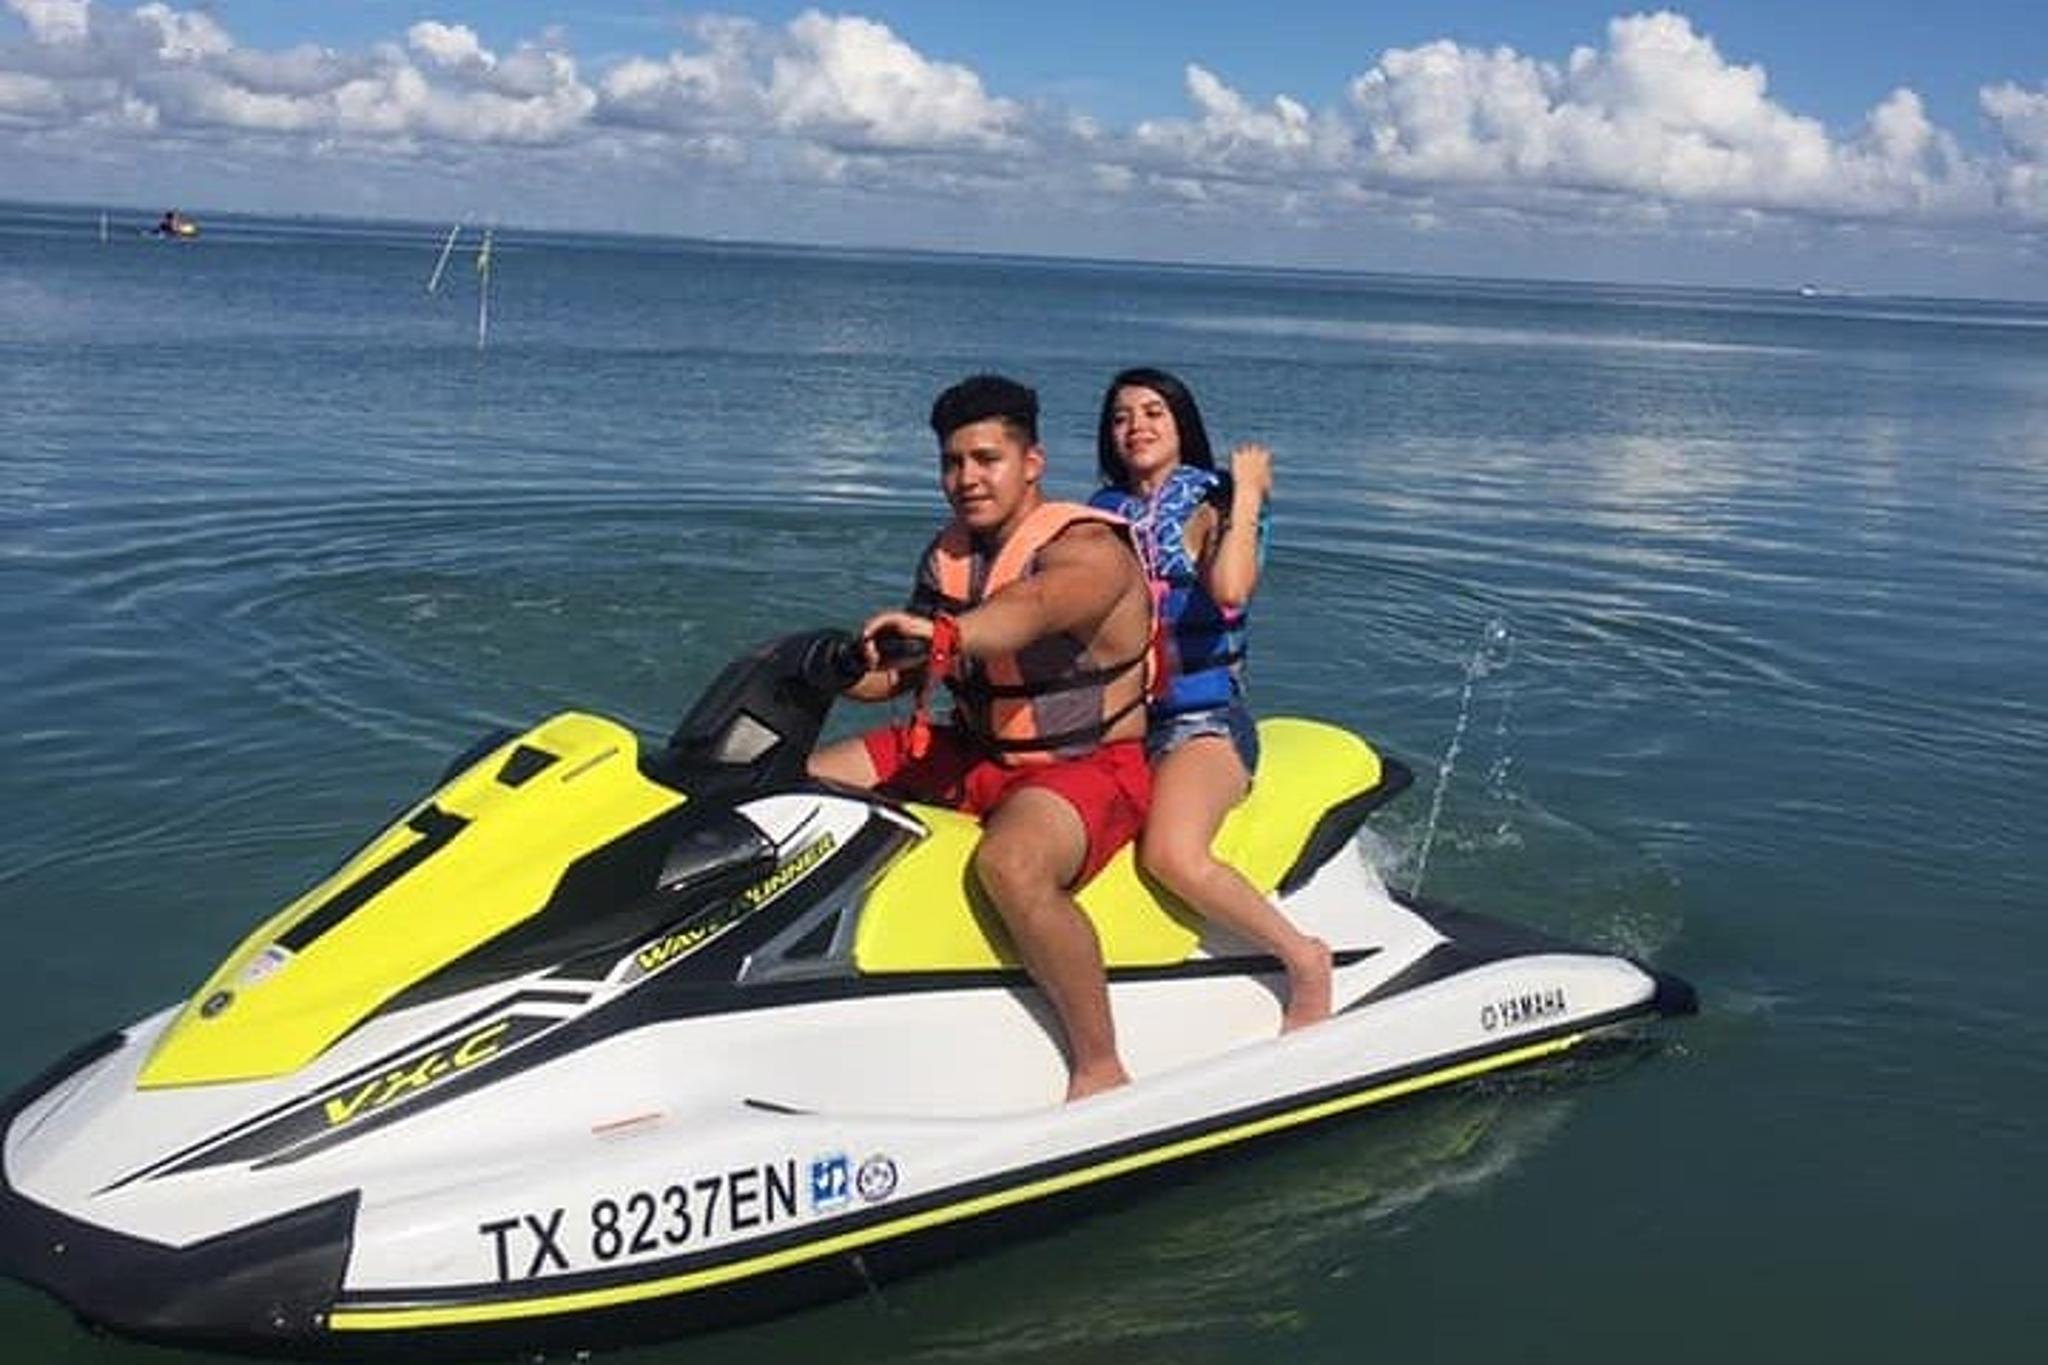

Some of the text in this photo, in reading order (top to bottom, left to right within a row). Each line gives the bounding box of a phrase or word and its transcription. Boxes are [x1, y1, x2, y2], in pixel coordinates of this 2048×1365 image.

[636, 831, 837, 972] WAVUNNER
[1499, 986, 1567, 1028] YAMAHA
[479, 1207, 570, 1283] TX
[591, 1158, 799, 1262] 8237EN
